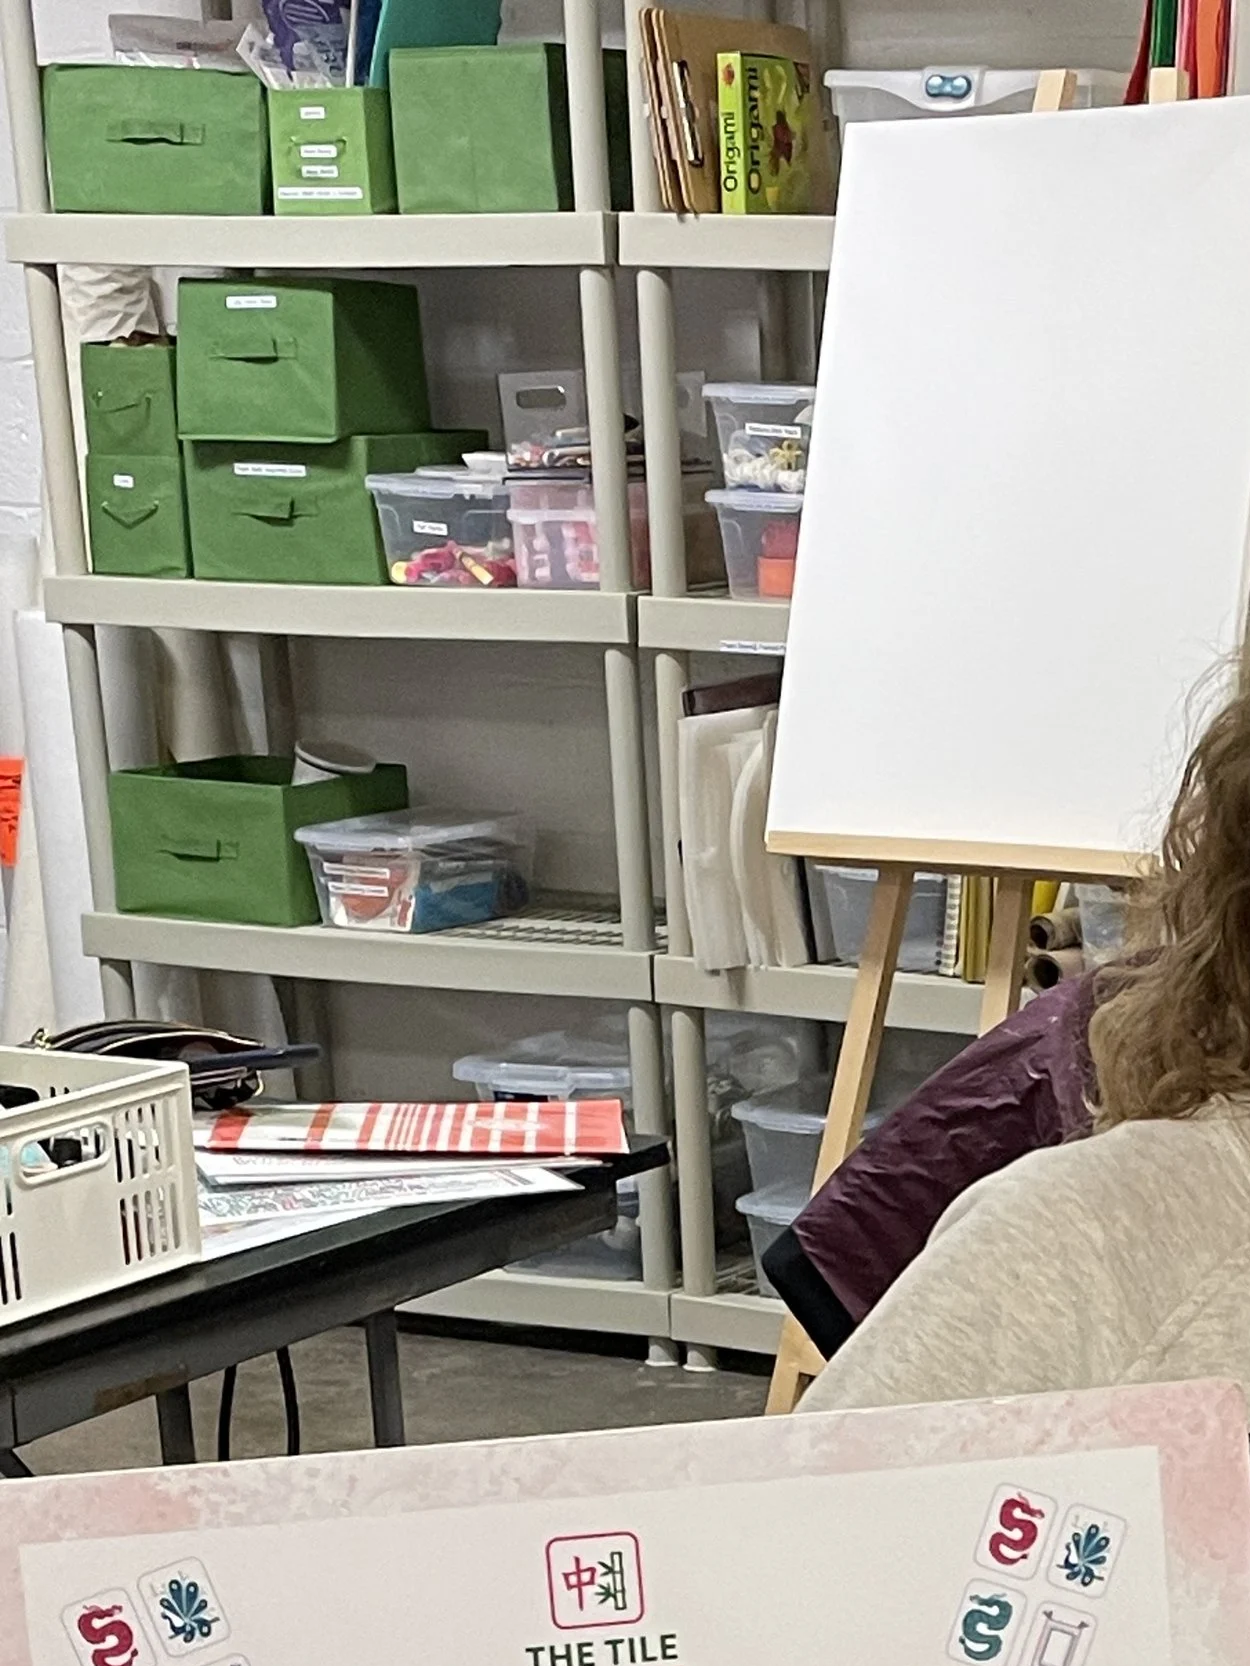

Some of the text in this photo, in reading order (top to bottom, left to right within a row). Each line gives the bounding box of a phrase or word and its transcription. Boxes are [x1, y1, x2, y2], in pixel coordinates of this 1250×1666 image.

[721, 111, 741, 192] Origami
[747, 66, 764, 195] Origami
[604, 1633, 678, 1666] TILE
